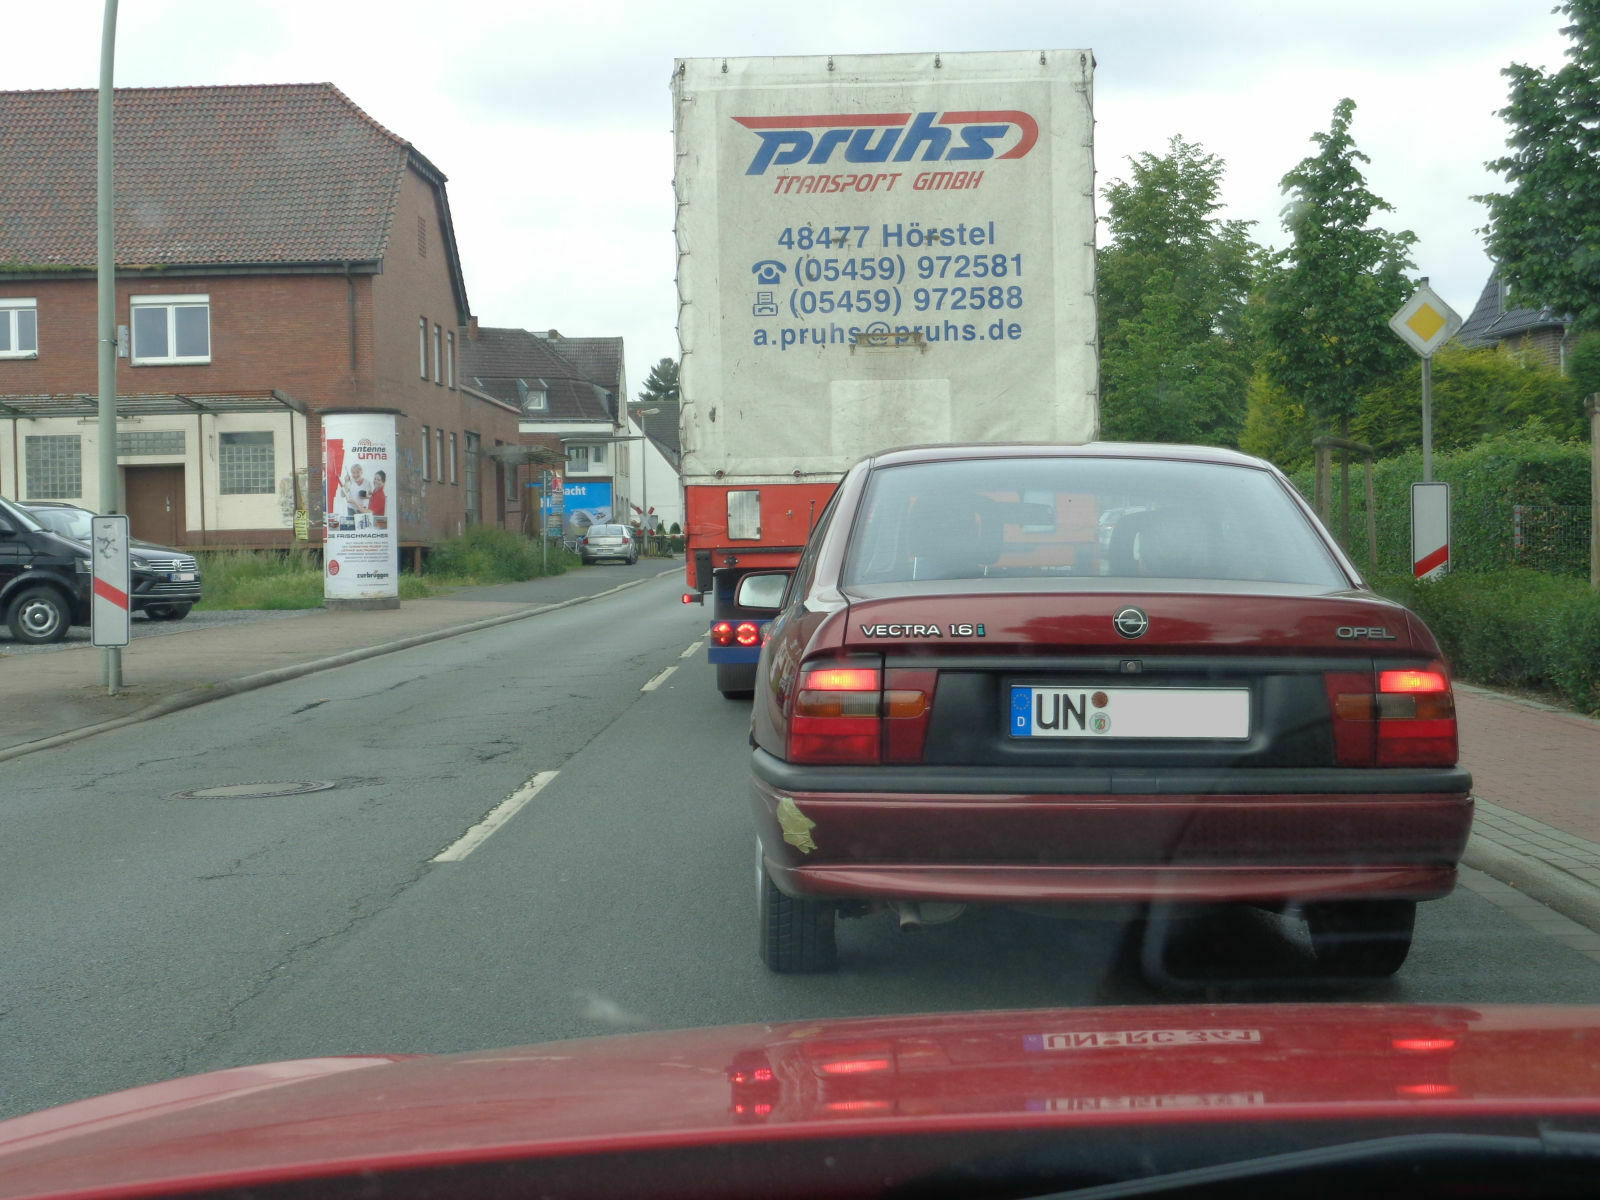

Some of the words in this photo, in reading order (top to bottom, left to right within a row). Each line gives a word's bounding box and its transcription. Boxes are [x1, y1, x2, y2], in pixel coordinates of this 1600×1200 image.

[745, 112, 1010, 175] pruhs
[774, 173, 902, 194] TRANSPORT
[913, 170, 984, 191] GMBH
[778, 226, 870, 251] 48477
[883, 222, 995, 248] Hörstel
[794, 256, 906, 286] (05459)
[918, 253, 1023, 280] 972581
[790, 288, 902, 318] (05459)
[914, 286, 1023, 312] 972588
[358, 452, 387, 460] unna
[860, 623, 942, 637] VECTRA
[1336, 625, 1397, 640] OPEL
[1035, 693, 1087, 731] UN
